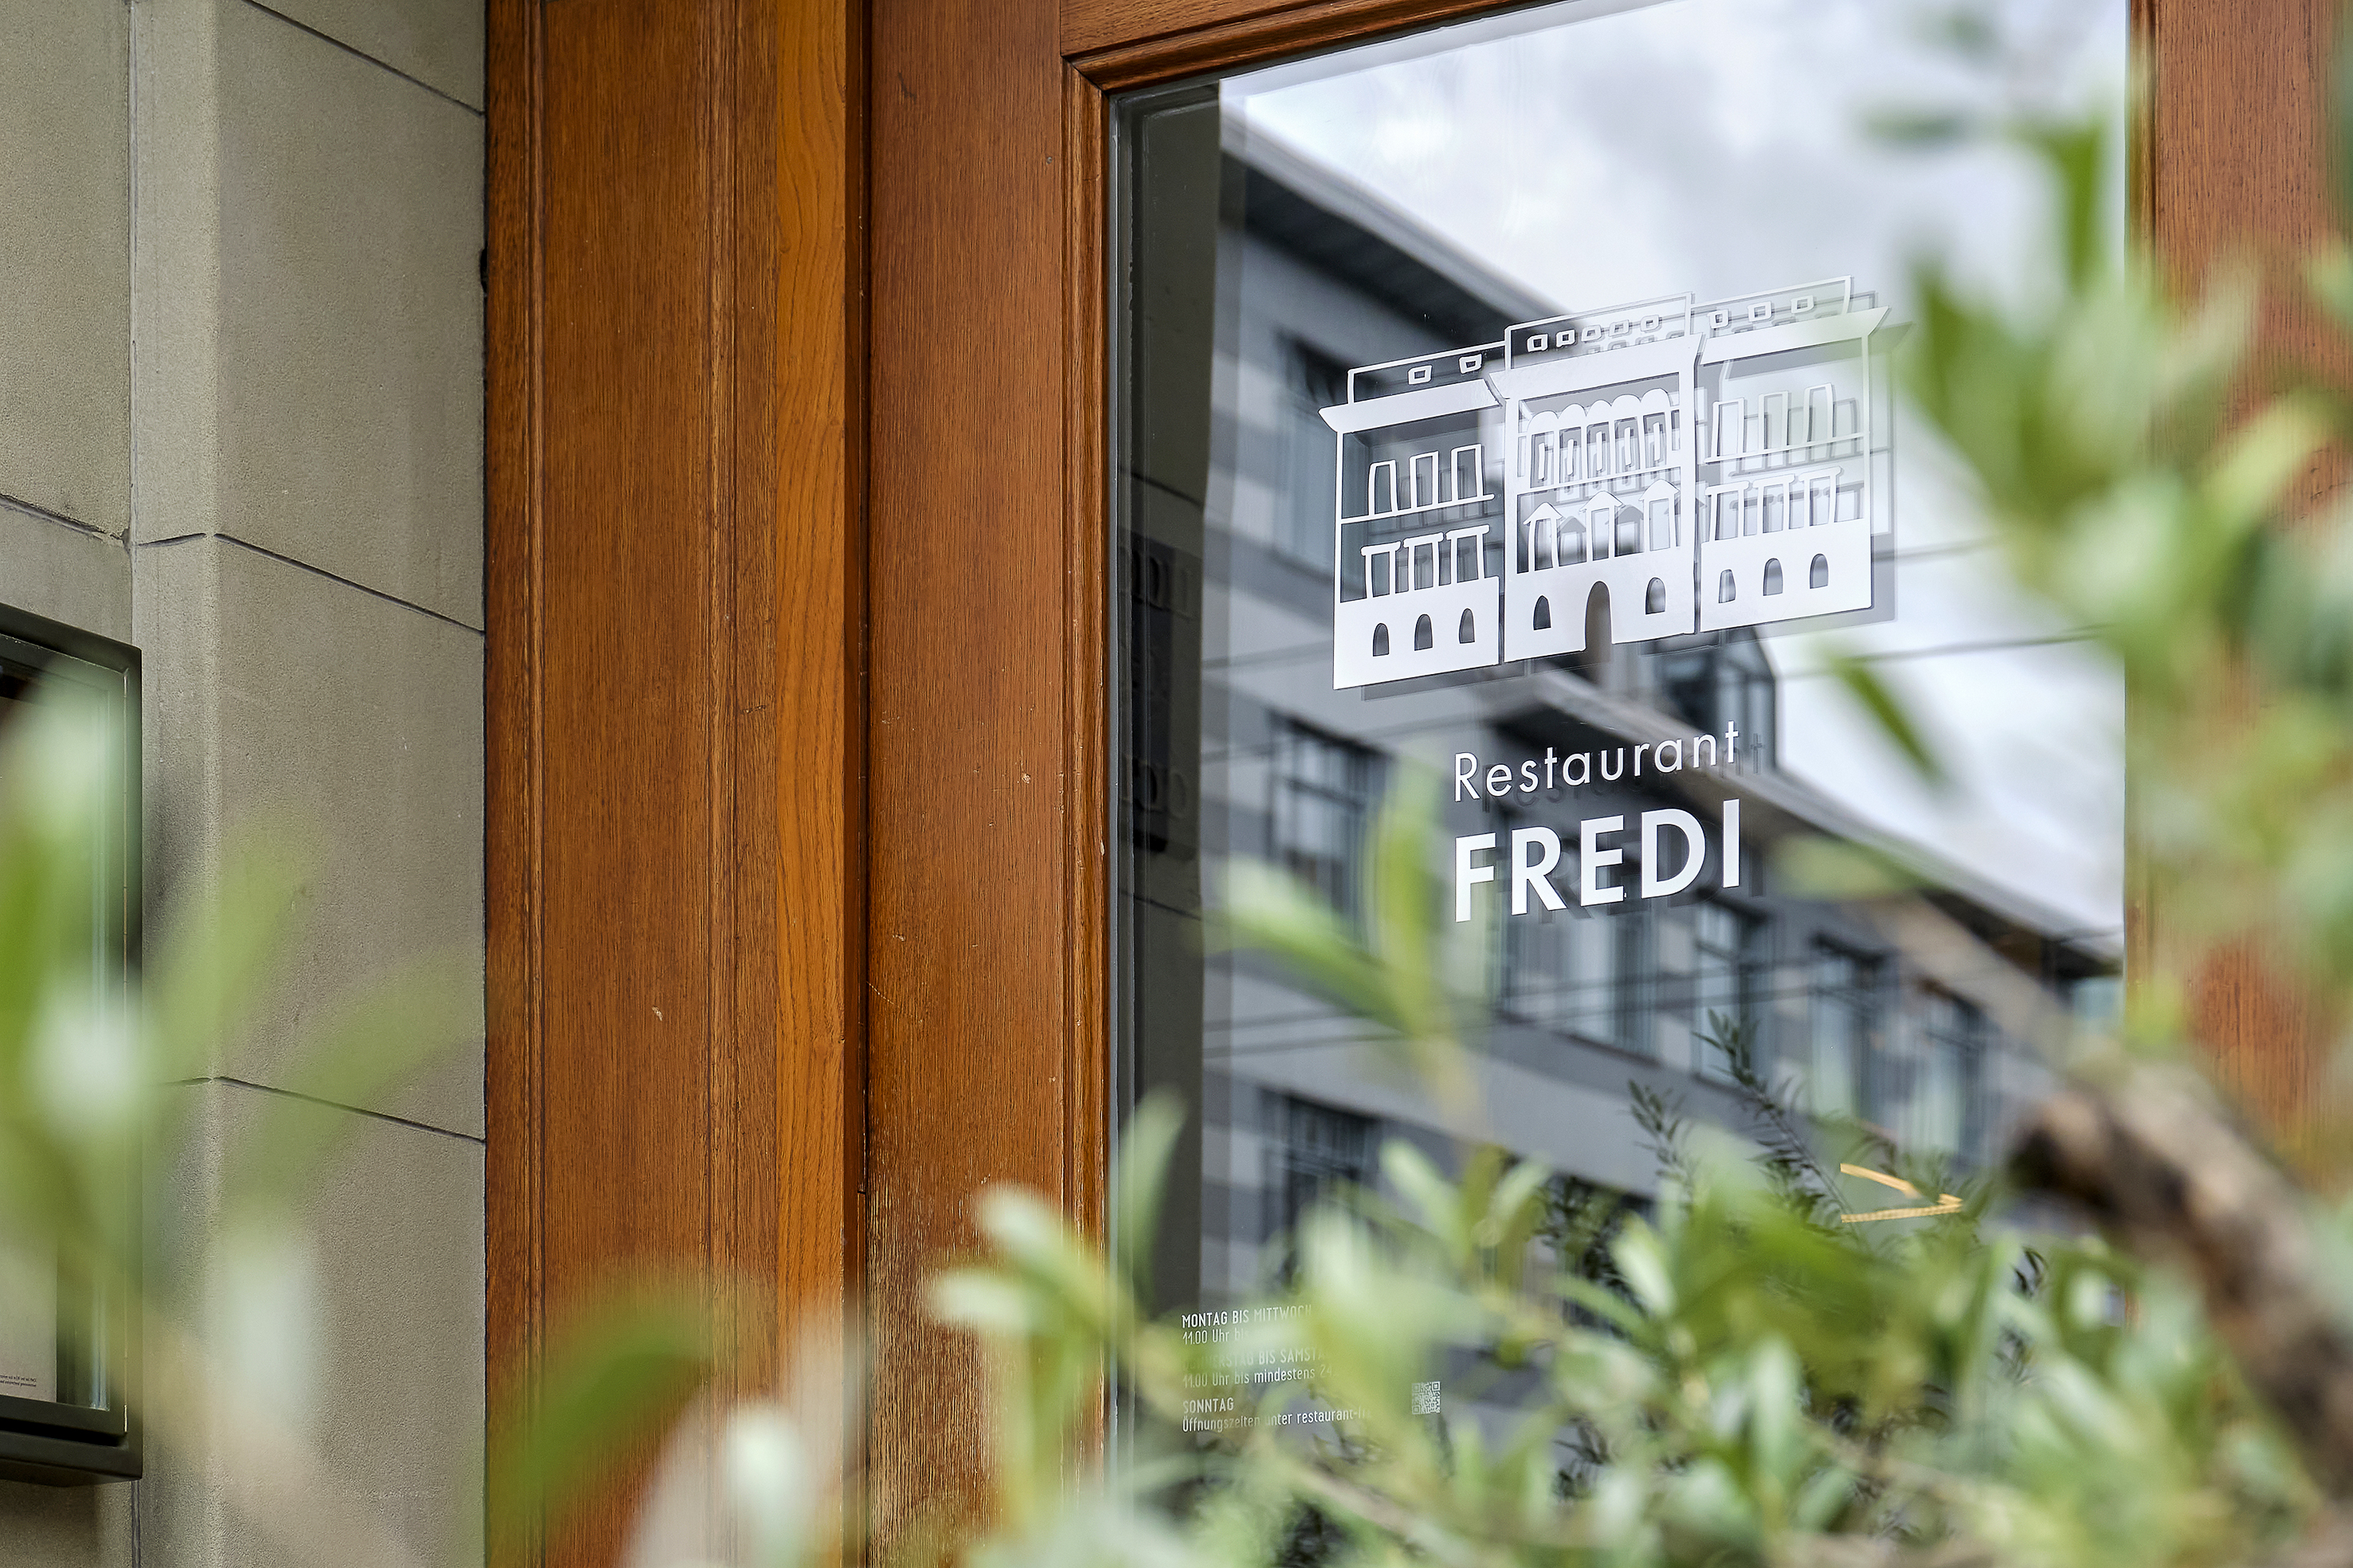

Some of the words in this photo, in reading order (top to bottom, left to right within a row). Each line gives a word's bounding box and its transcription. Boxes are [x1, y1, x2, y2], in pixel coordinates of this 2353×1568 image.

[1455, 720, 1739, 802] Restaurant
[1455, 799, 1740, 923] FREDI
[1182, 1311, 1228, 1328] MONTAG
[1232, 1309, 1249, 1324] BIS
[1253, 1304, 1312, 1323] MITTWOCH
[1182, 1330, 1208, 1345] 11.00
[1212, 1329, 1229, 1343] Uhr
[1259, 1349, 1276, 1365] BIS
[1280, 1347, 1329, 1364] SAMSTA
[1182, 1374, 1208, 1389] 11.00
[1212, 1372, 1229, 1386] Uhr
[1234, 1370, 1250, 1385] bis
[1254, 1367, 1316, 1384] mindestens
[1182, 1397, 1234, 1413] SONNTAG
[1182, 1414, 1261, 1433] Öffnungszeiten
[1265, 1413, 1292, 1426] unter
[1296, 1405, 1371, 1425] restaurant-fr
